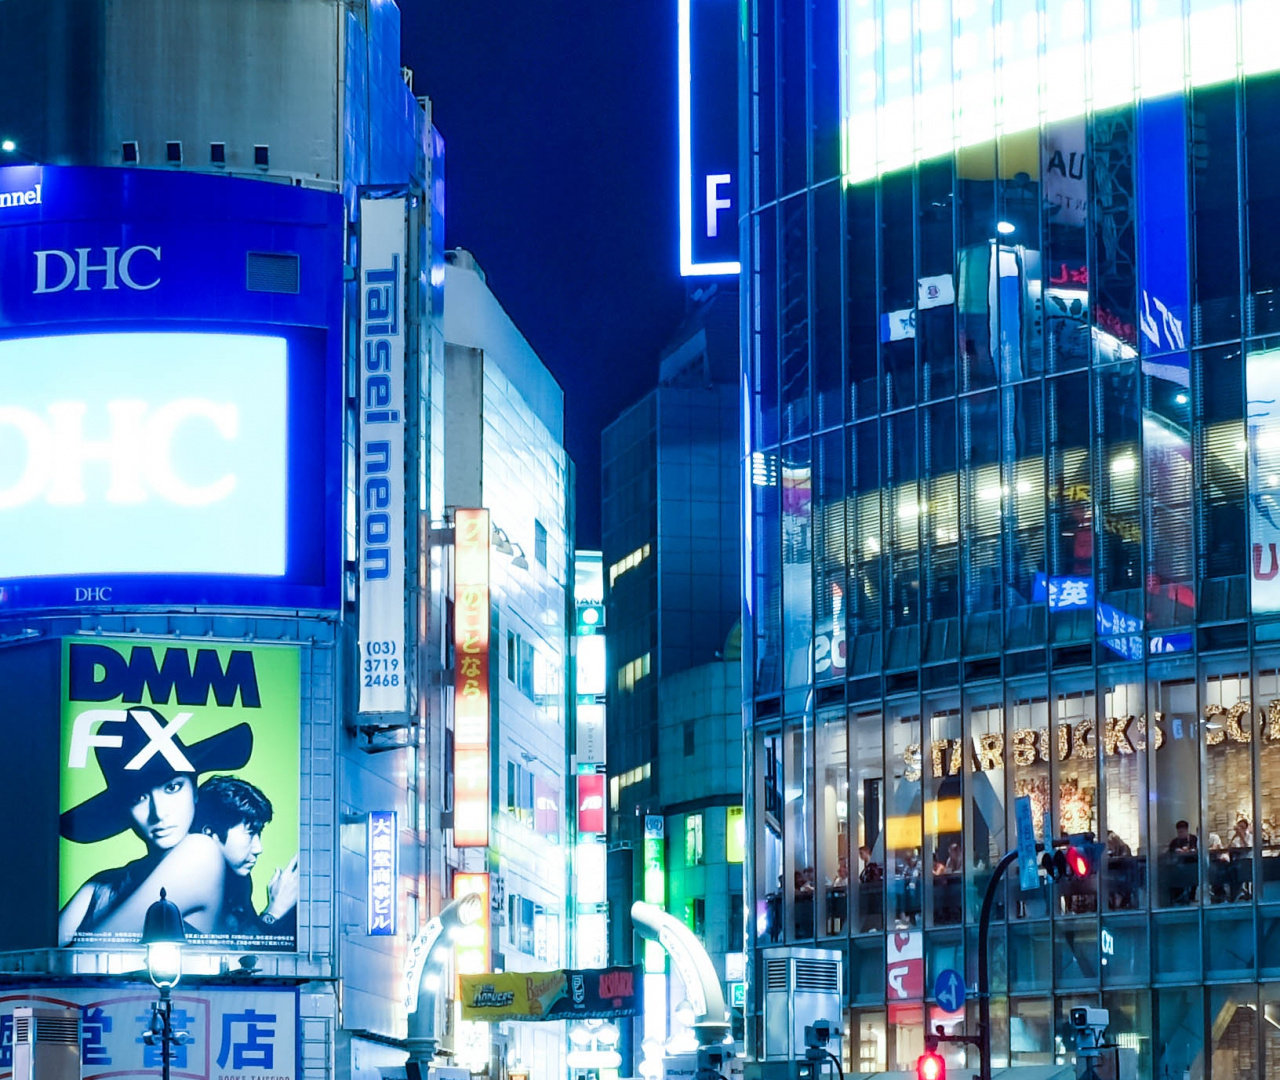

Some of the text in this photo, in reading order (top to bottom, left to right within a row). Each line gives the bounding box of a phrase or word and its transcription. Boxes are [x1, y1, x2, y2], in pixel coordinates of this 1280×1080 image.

[32, 245, 162, 295] DHC
[364, 252, 400, 582] Taisei neon
[75, 587, 113, 602] DHC
[365, 640, 396, 656] (03)
[68, 643, 262, 708] DMM
[364, 658, 400, 673] 3719
[364, 674, 400, 689] 2468
[67, 708, 196, 772] FX
[902, 712, 1167, 783] STARBUCKS
[666, 1069, 695, 1077] Enjoy
